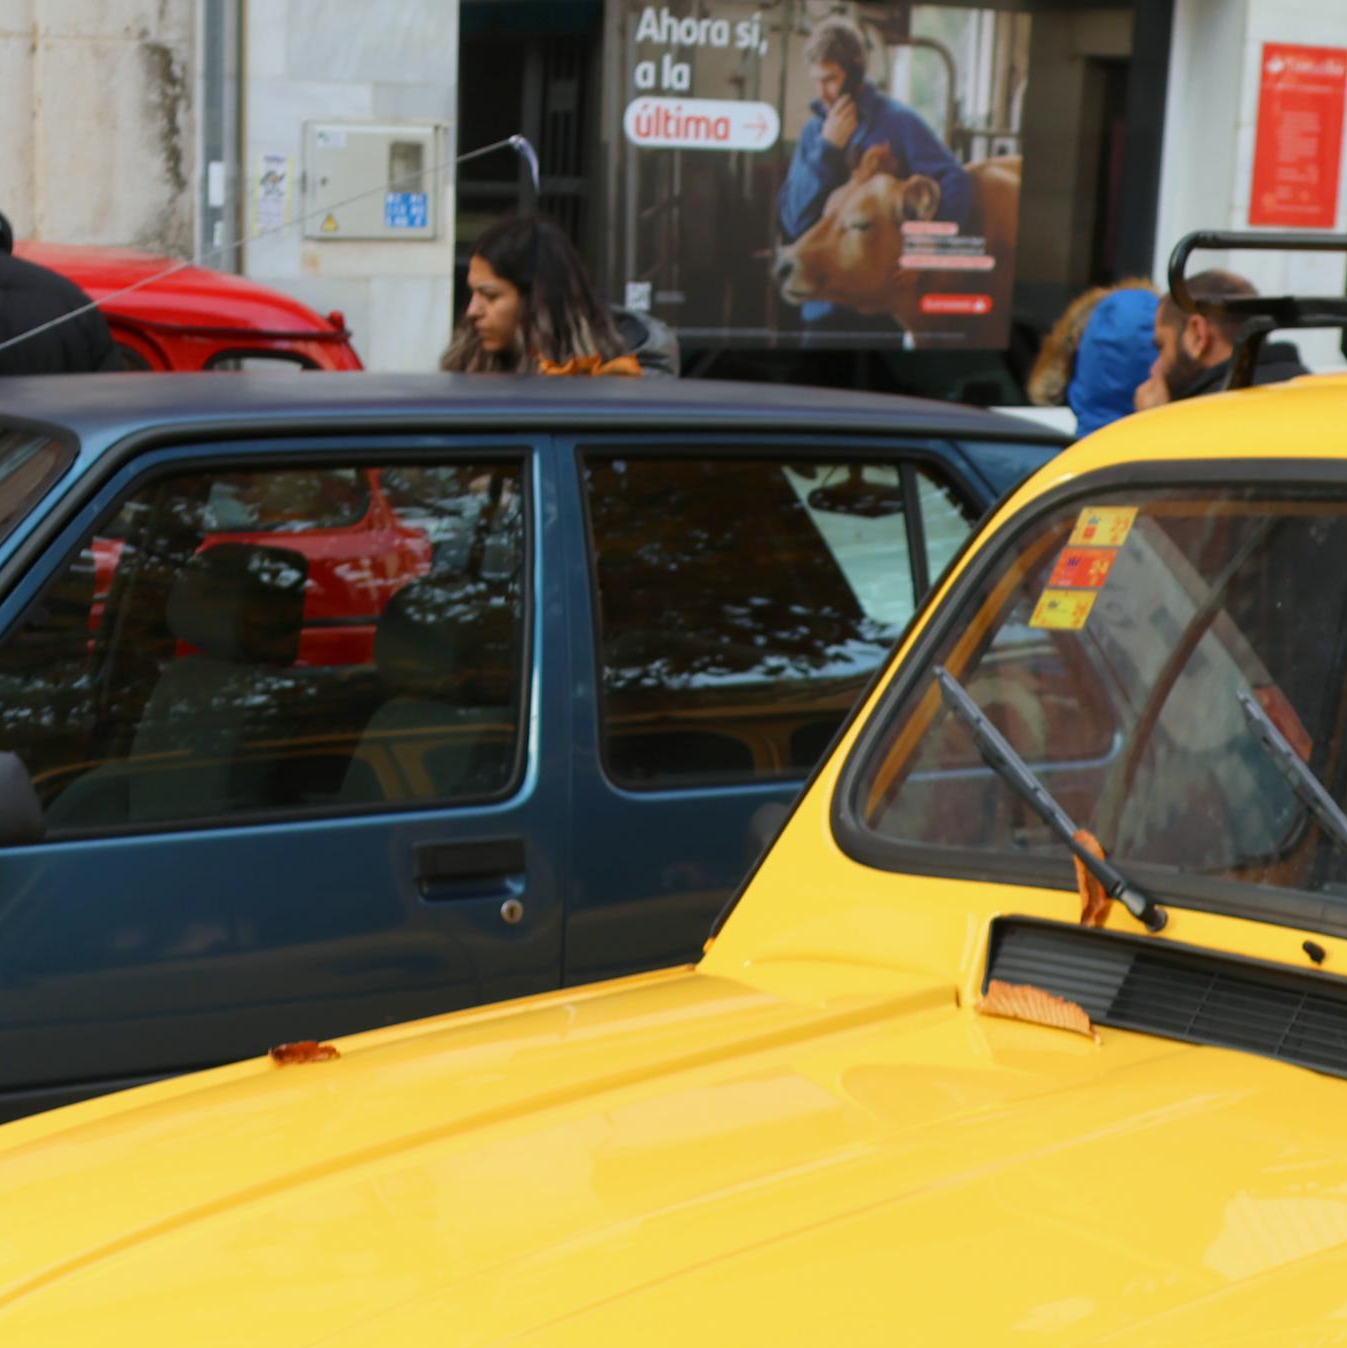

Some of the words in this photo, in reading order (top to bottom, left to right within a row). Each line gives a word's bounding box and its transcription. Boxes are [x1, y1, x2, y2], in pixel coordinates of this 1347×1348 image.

[635, 6, 730, 47] Ahora
[735, 11, 768, 57] sí,
[634, 60, 655, 90] a
[661, 53, 691, 91] la
[635, 102, 730, 141] última
